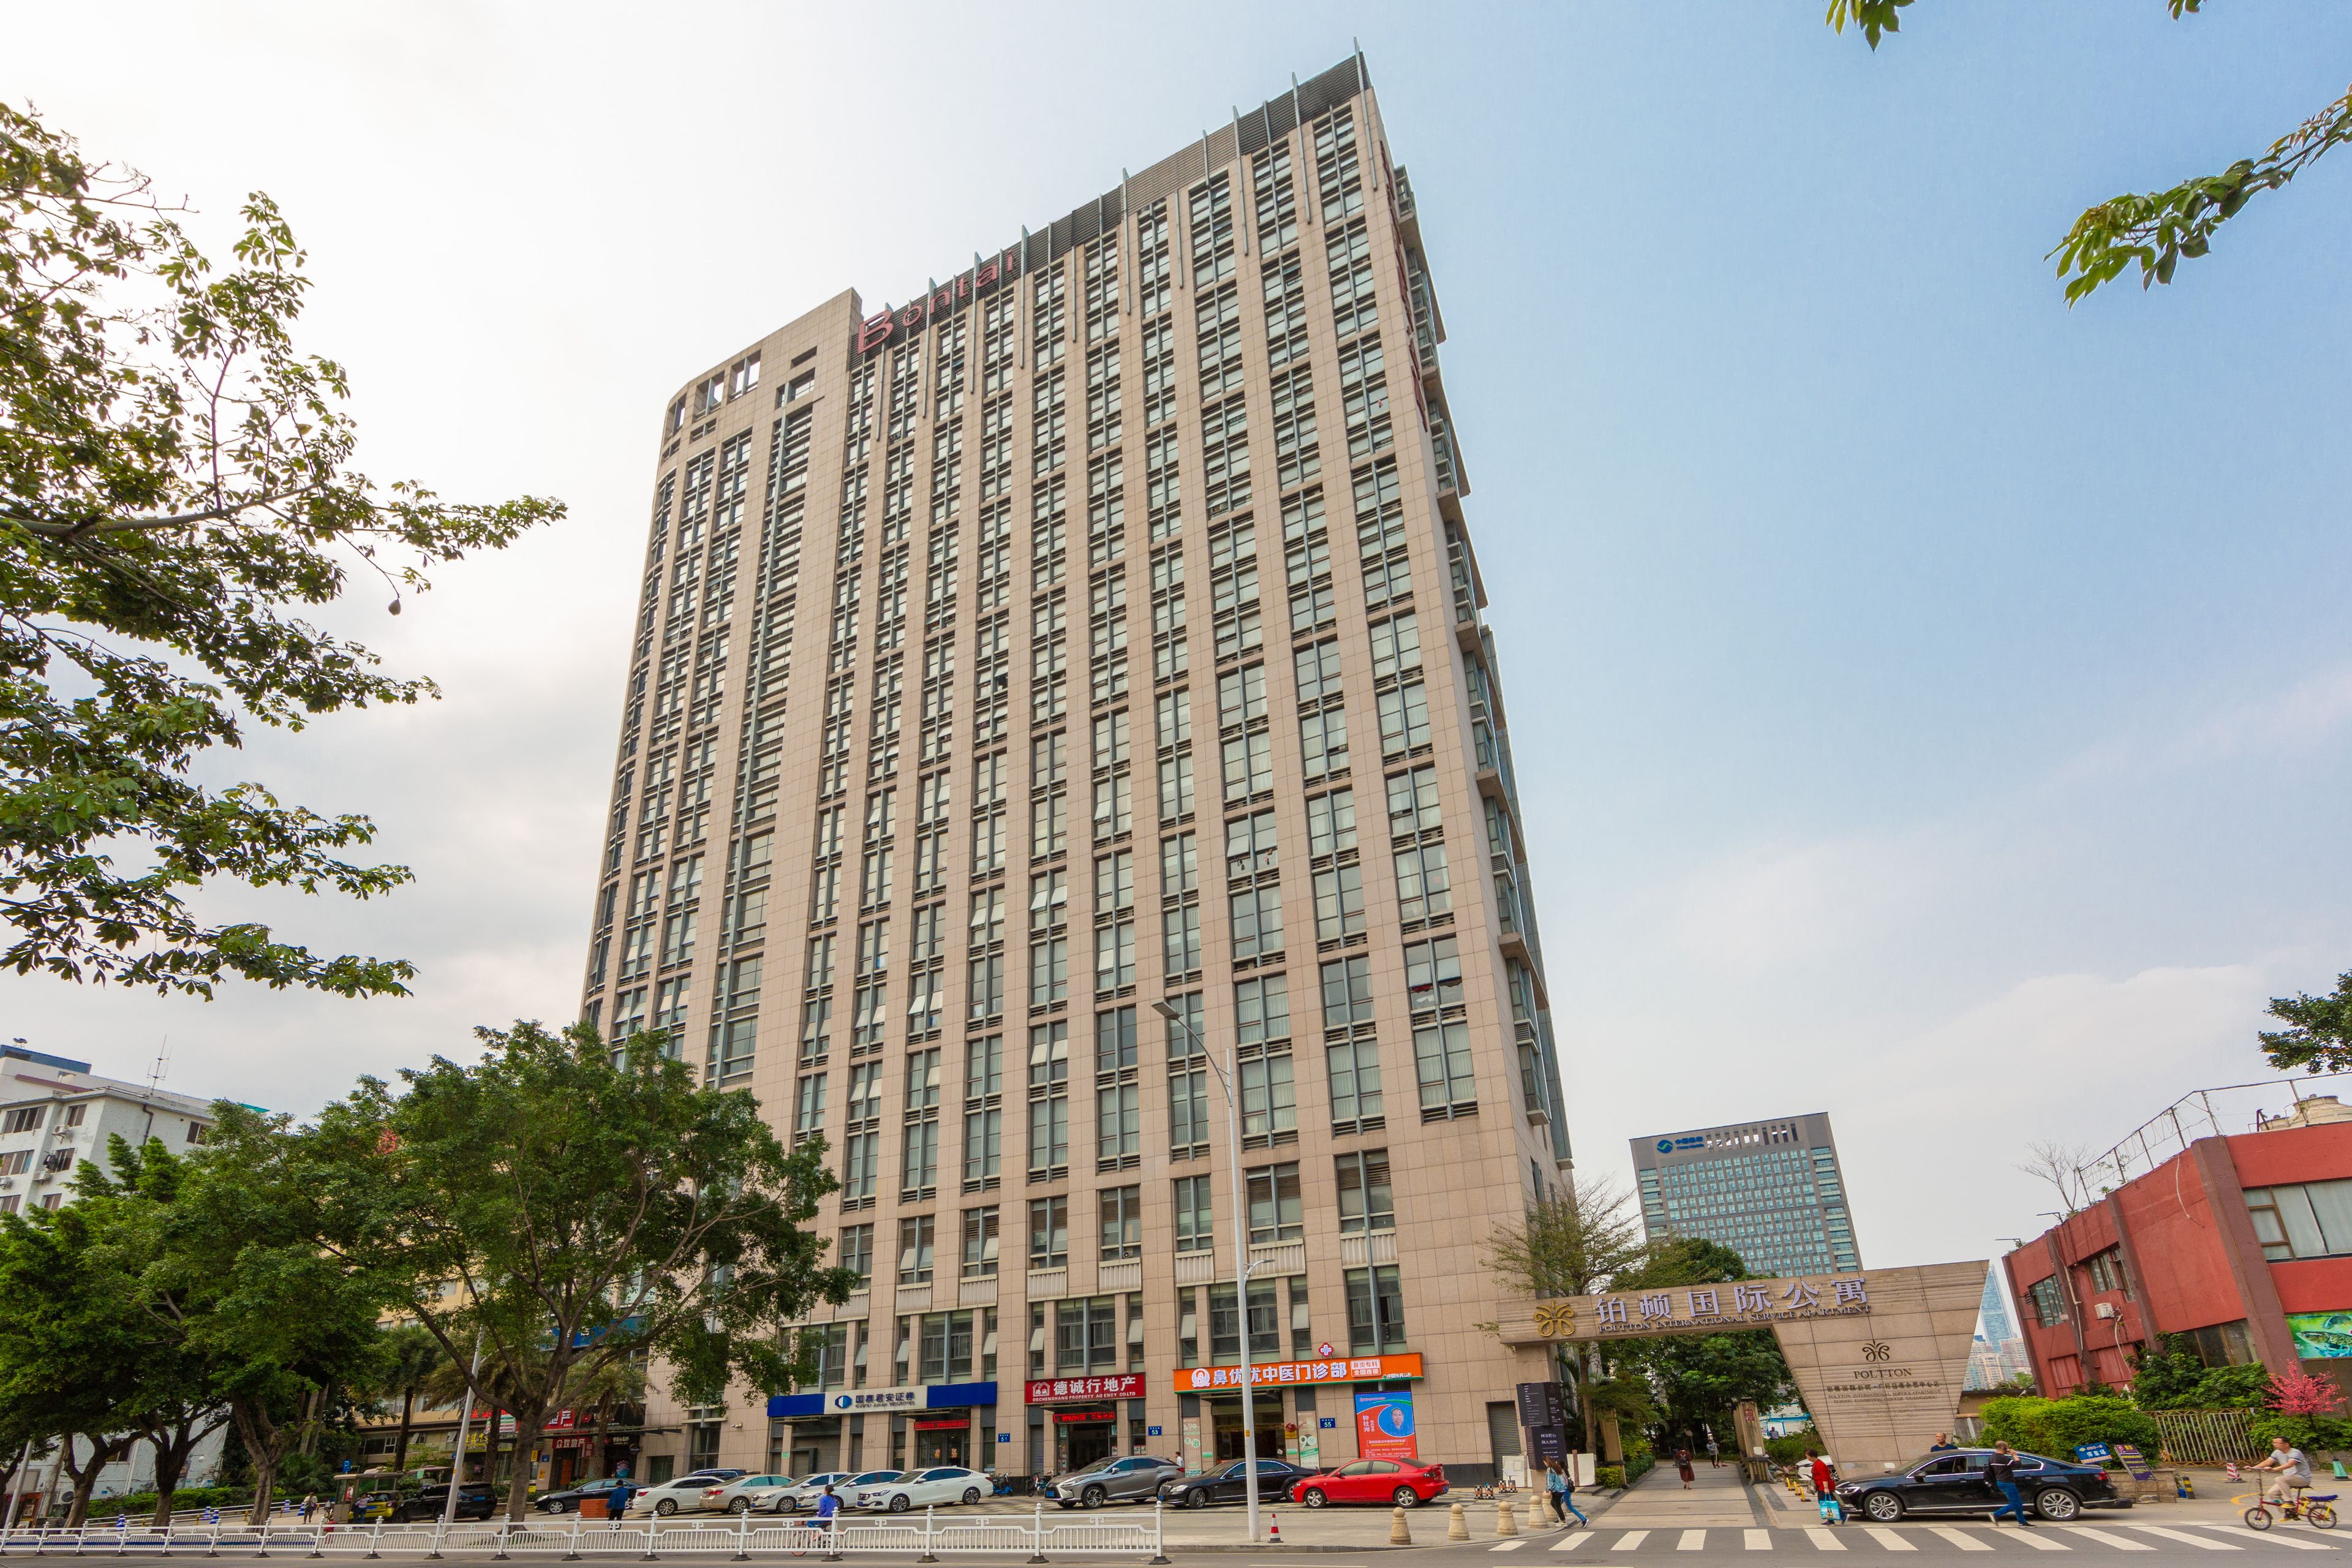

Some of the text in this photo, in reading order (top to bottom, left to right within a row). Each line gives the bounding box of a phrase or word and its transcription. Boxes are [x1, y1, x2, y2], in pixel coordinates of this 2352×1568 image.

[858, 249, 1013, 355] Bontai
[1596, 1278, 1867, 1324] 铂顿国际公寓
[1599, 1305, 1871, 1333] POLTTON INTERNATIONAL SERVICE APARTMENT
[1853, 1368, 1912, 1379] POLTTON
[1054, 1376, 1136, 1395] 德诚行地产
[856, 1392, 915, 1403] 国泰君安证券
